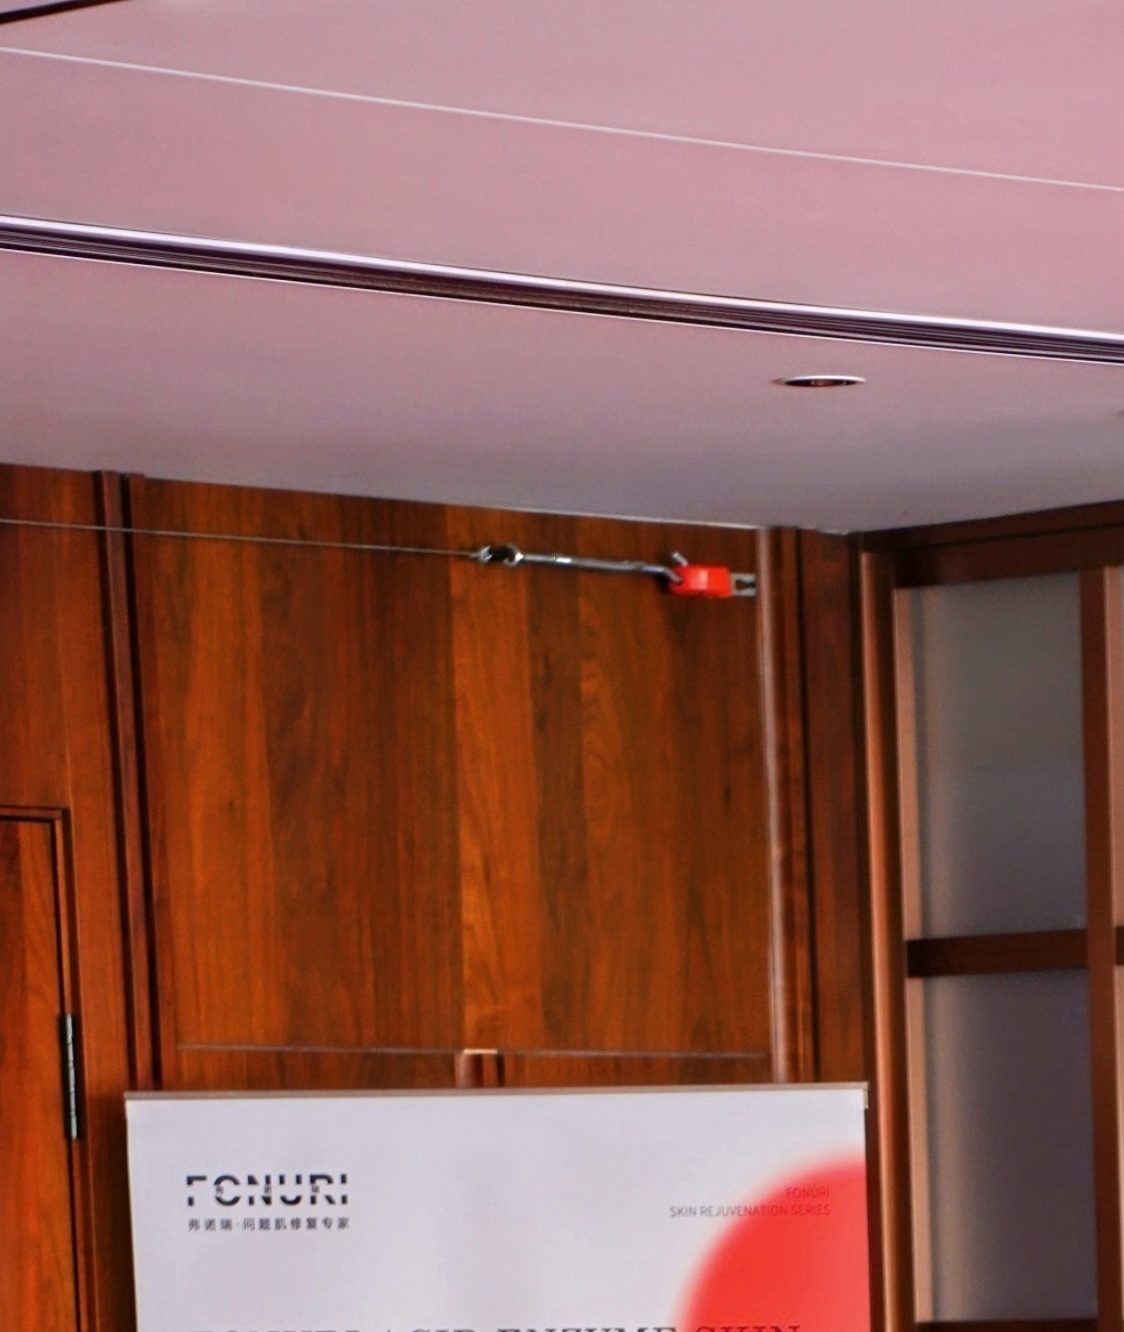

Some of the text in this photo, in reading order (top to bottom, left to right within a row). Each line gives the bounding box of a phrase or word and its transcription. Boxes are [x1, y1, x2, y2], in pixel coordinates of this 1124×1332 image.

[186, 1173, 349, 1207] FONURI
[669, 1203, 832, 1218] SKIN REJUVENATION SERIES
